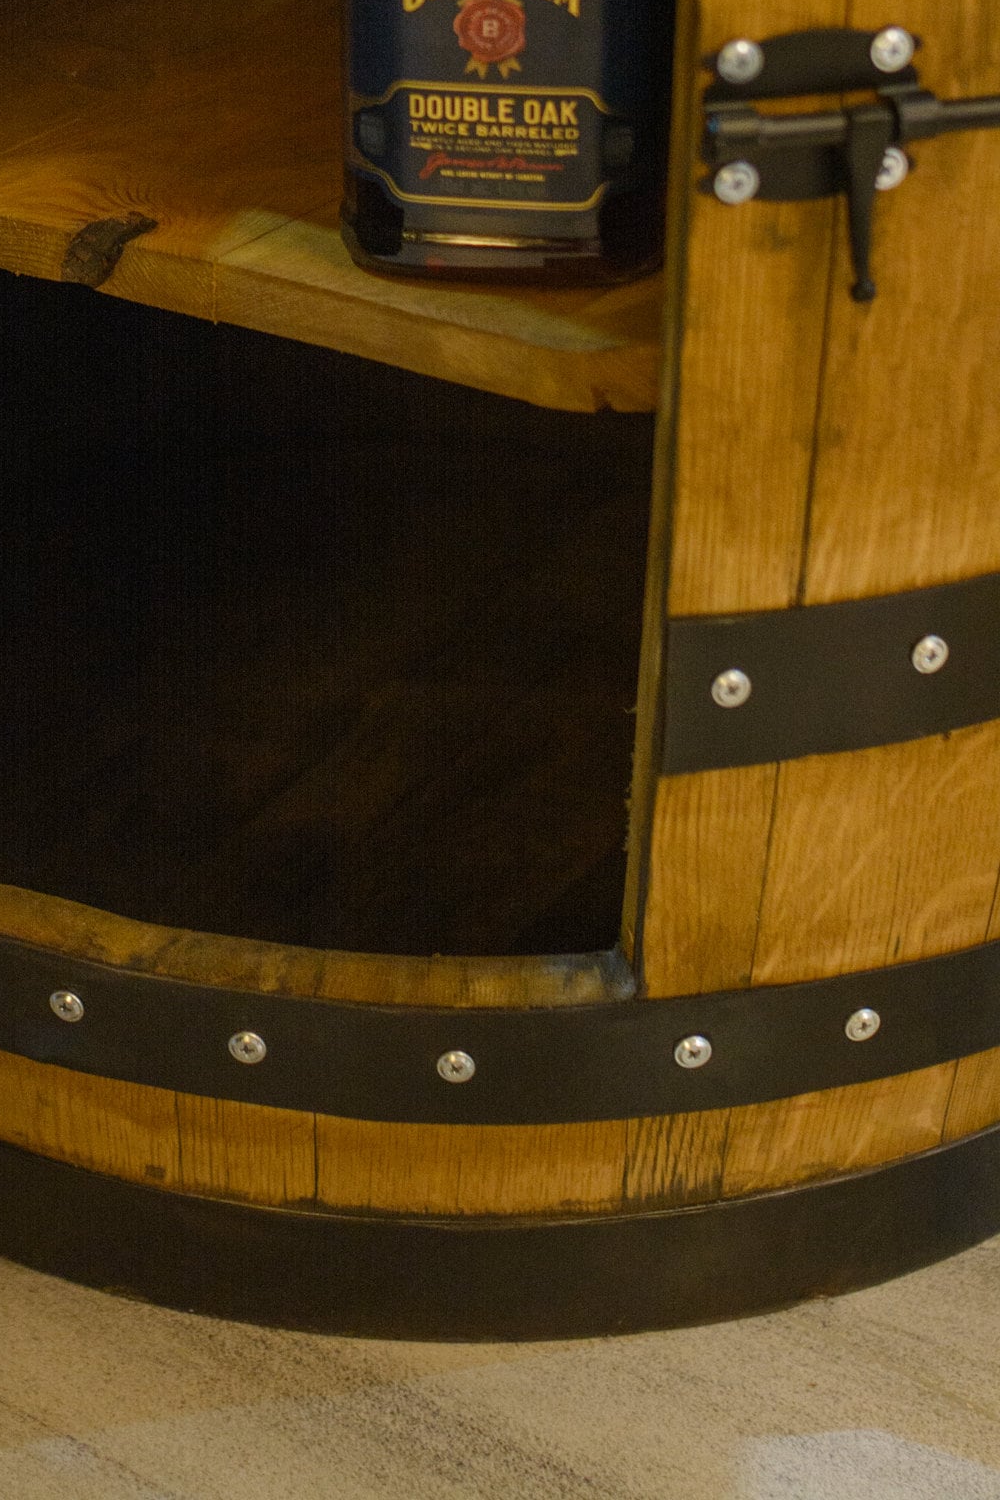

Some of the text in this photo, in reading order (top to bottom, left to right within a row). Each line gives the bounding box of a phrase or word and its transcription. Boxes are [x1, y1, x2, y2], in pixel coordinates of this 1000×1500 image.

[482, 19, 499, 38] B
[409, 94, 578, 125] DOUBLE OAK
[409, 120, 580, 140] TWICE BARRELED
